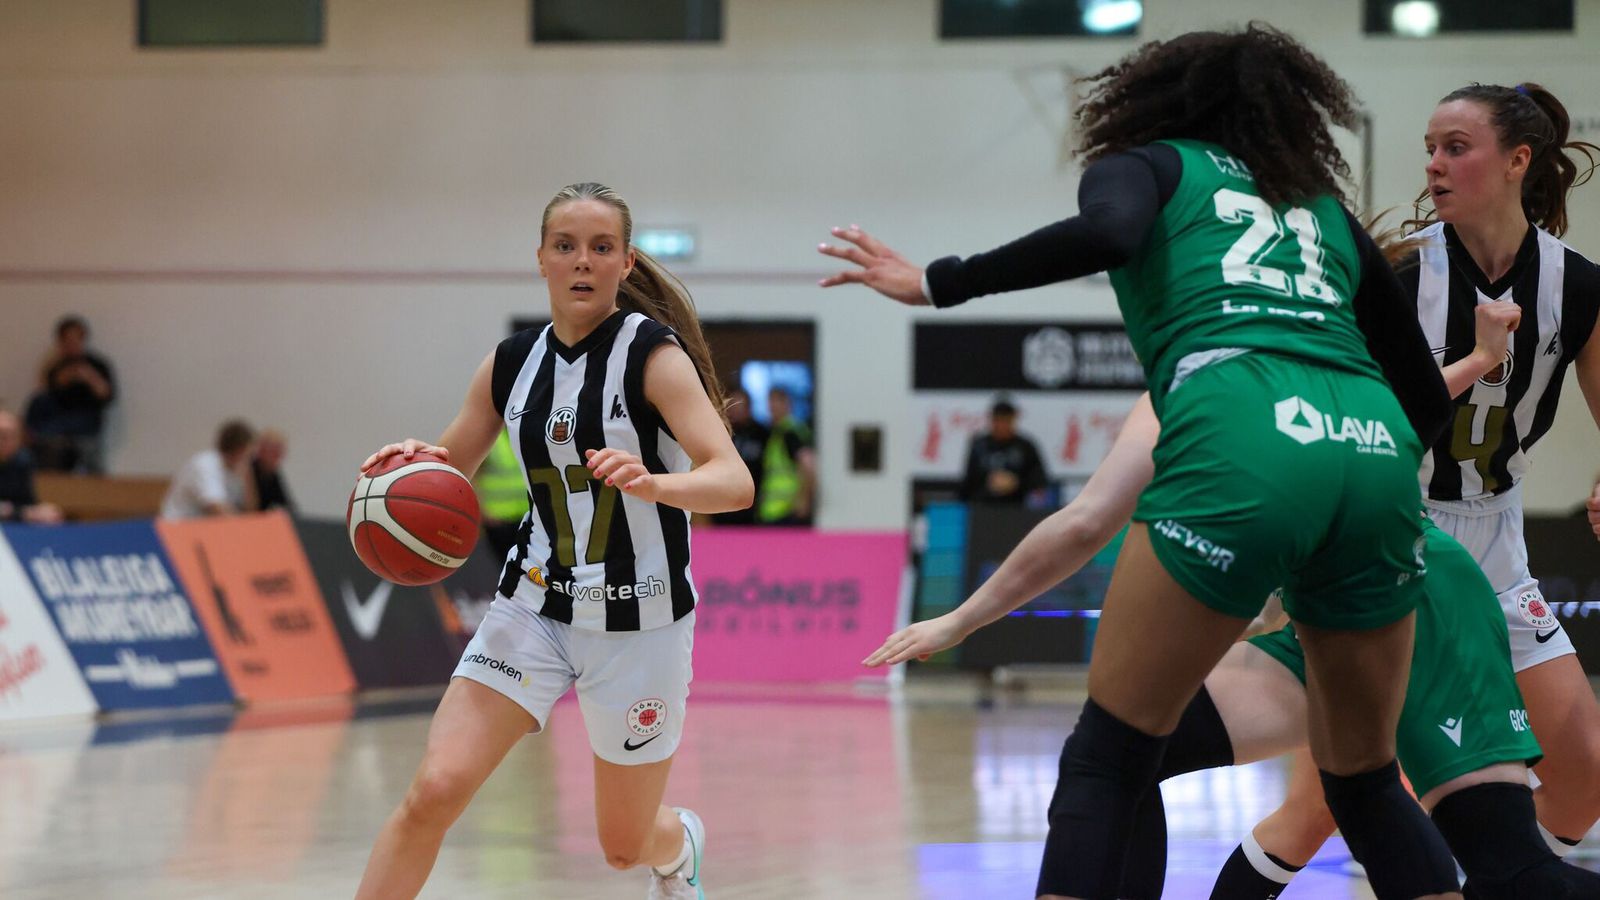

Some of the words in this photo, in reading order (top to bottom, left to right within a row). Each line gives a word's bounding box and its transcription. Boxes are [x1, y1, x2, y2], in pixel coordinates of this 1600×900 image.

[1213, 188, 1342, 307] 21
[1324, 413, 1397, 449] LAVA
[1449, 404, 1509, 493] 4
[528, 463, 618, 568] 17
[551, 575, 666, 602] alvotech
[463, 653, 523, 682] unbroken
